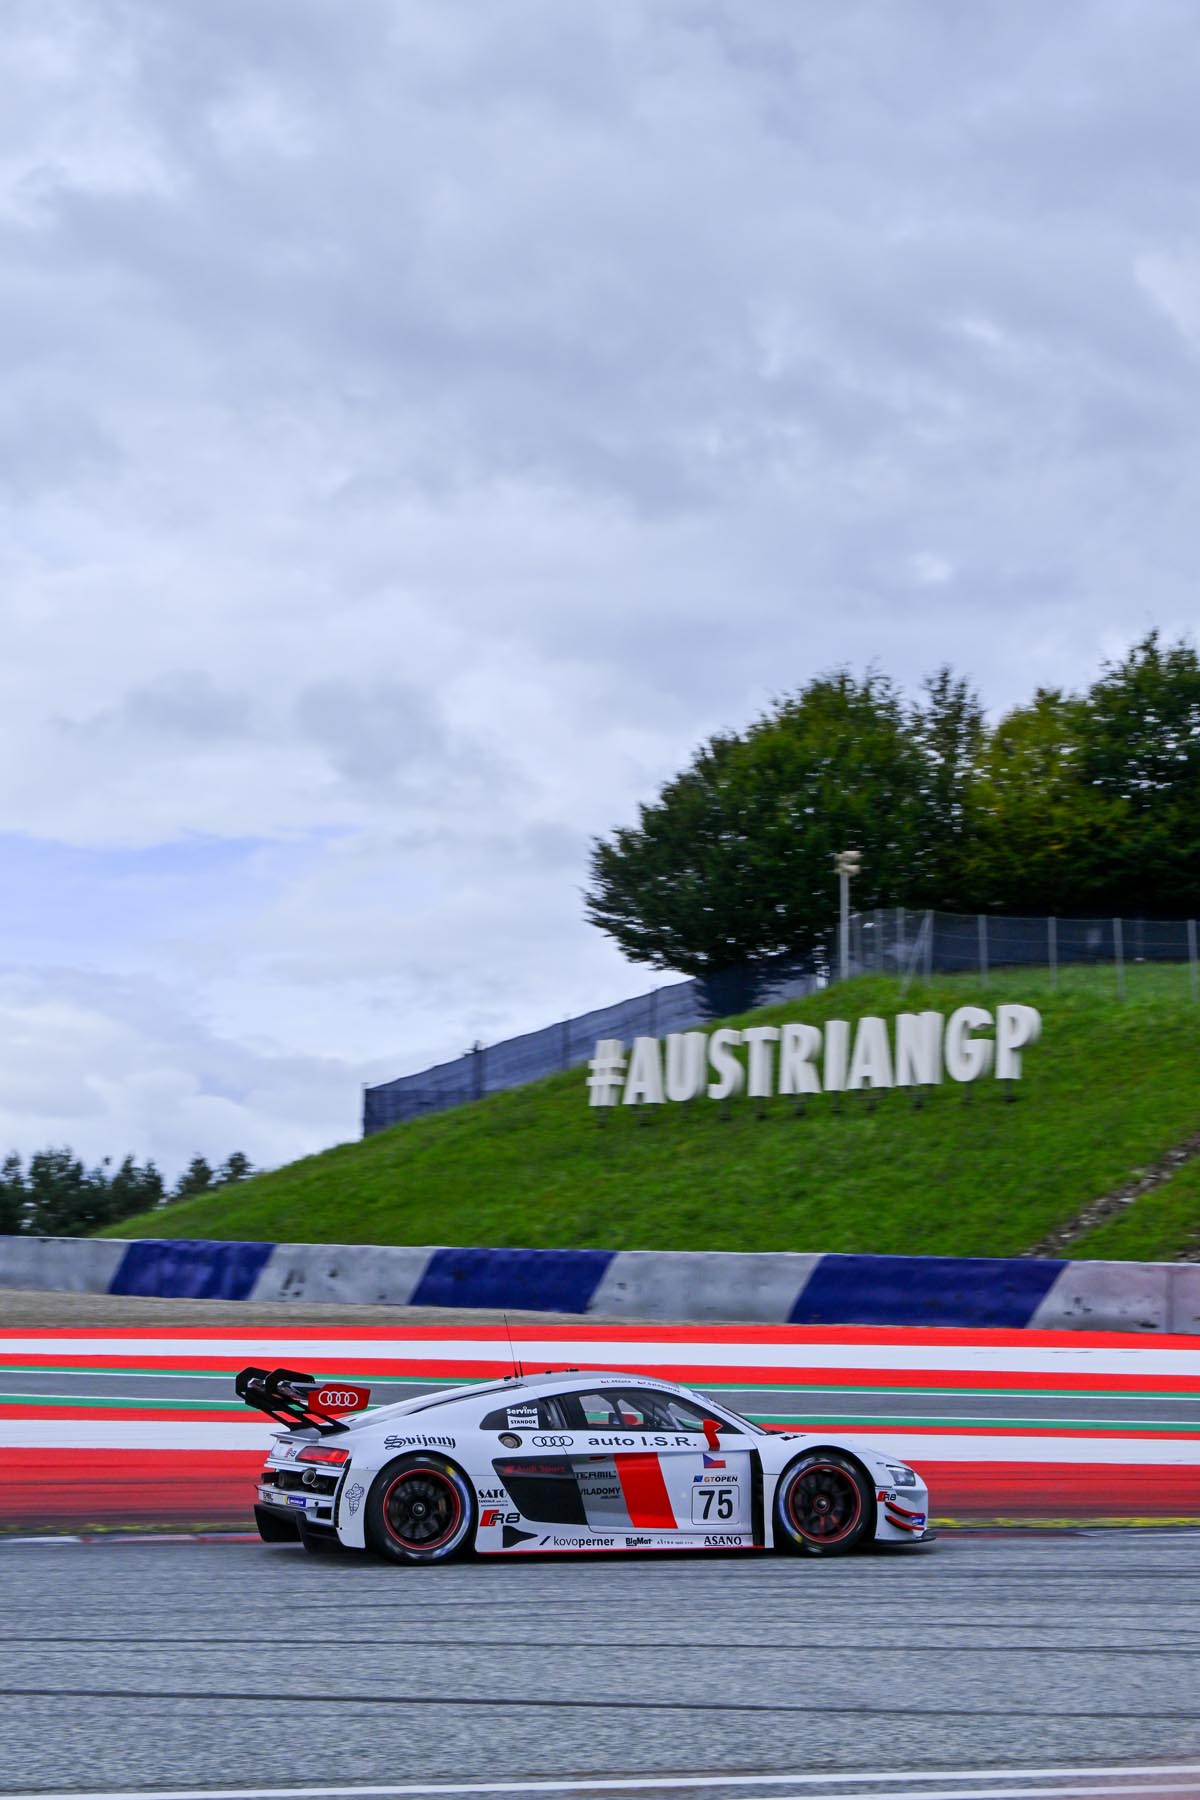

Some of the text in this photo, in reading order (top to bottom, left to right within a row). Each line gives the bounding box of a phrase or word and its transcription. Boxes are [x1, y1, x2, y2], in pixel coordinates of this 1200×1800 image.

[586, 1004, 1041, 1107] #AUSTRIANGP
[384, 1434, 456, 1450] Svijany
[588, 1436, 697, 1447] auto I.S.R.
[698, 1489, 733, 1520] 75
[488, 1512, 521, 1525] R8
[553, 1535, 615, 1548] kovoperner
[625, 1537, 652, 1546] BigMat
[704, 1535, 742, 1546] ASANO
